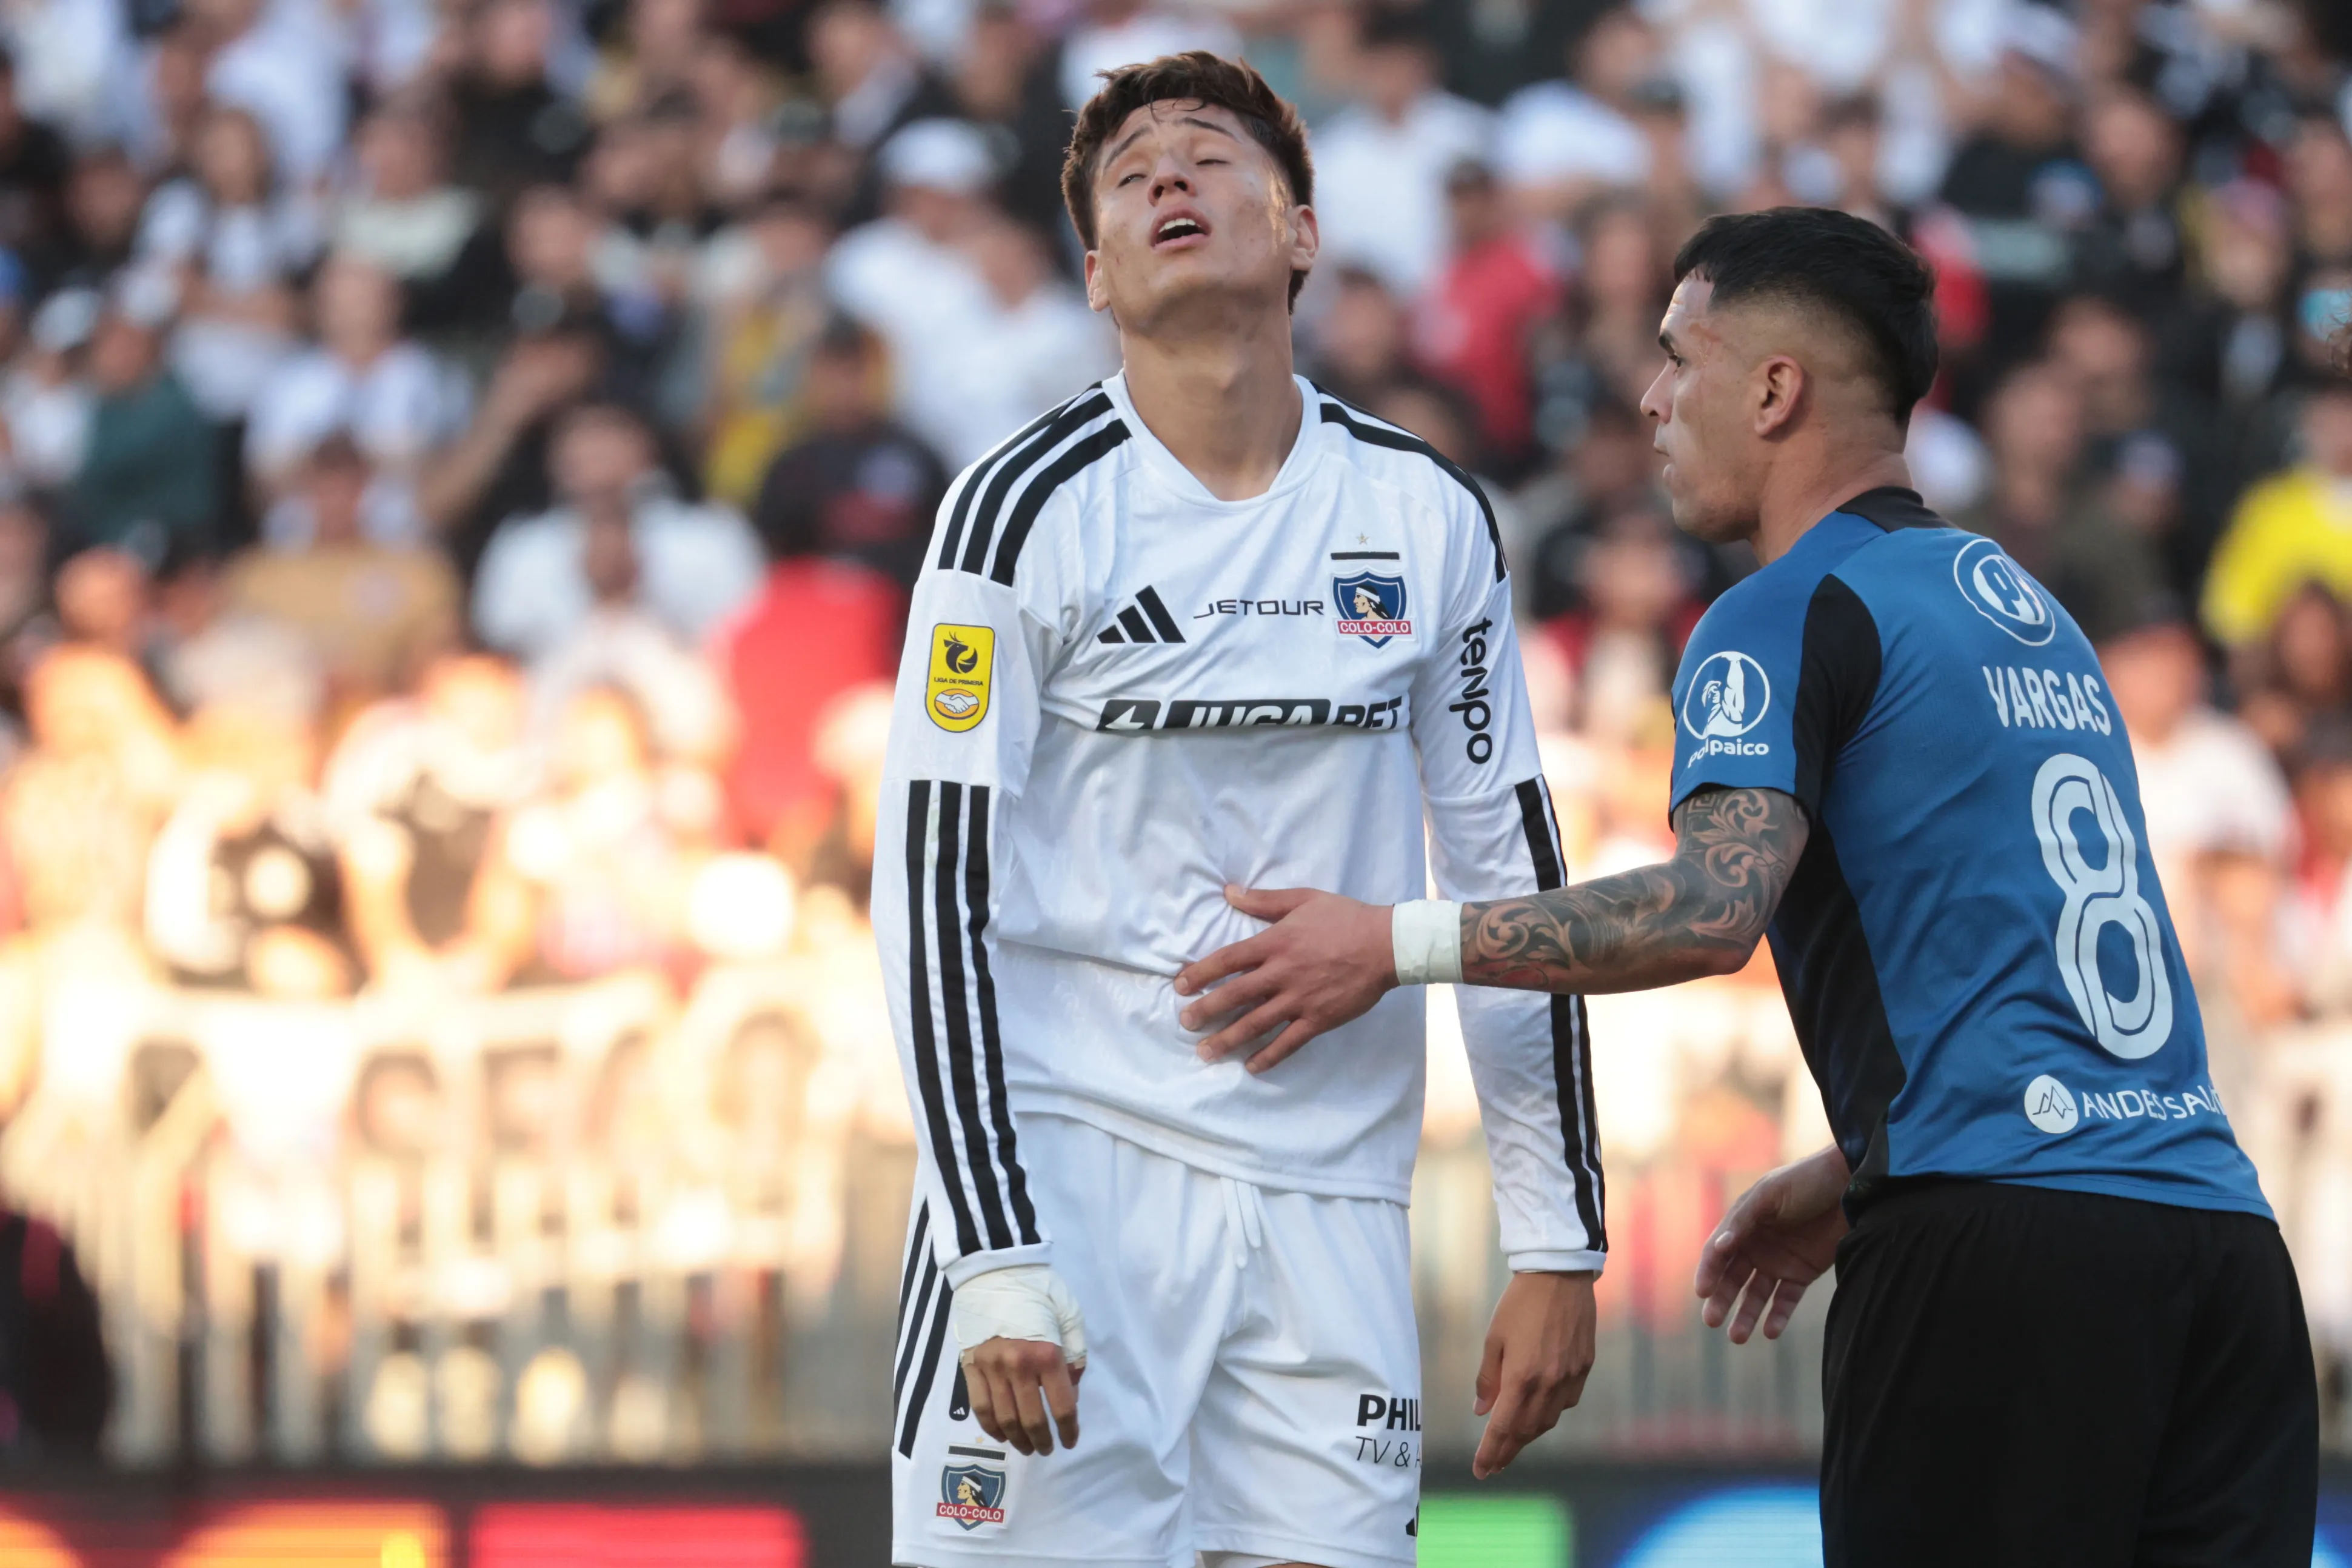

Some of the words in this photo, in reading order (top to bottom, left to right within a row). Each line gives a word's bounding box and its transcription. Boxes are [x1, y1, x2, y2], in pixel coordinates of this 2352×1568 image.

[1193, 599, 1325, 619] JETOUR
[1340, 621, 1410, 634] COLO-COLO
[1982, 666, 2111, 736] VARGAS
[1687, 737, 1769, 769] polpaico
[2031, 753, 2173, 1059] 8
[1355, 1435, 1391, 1464] TV
[1394, 1441, 1411, 1467] &
[939, 1505, 1001, 1521] COLO-COLO
